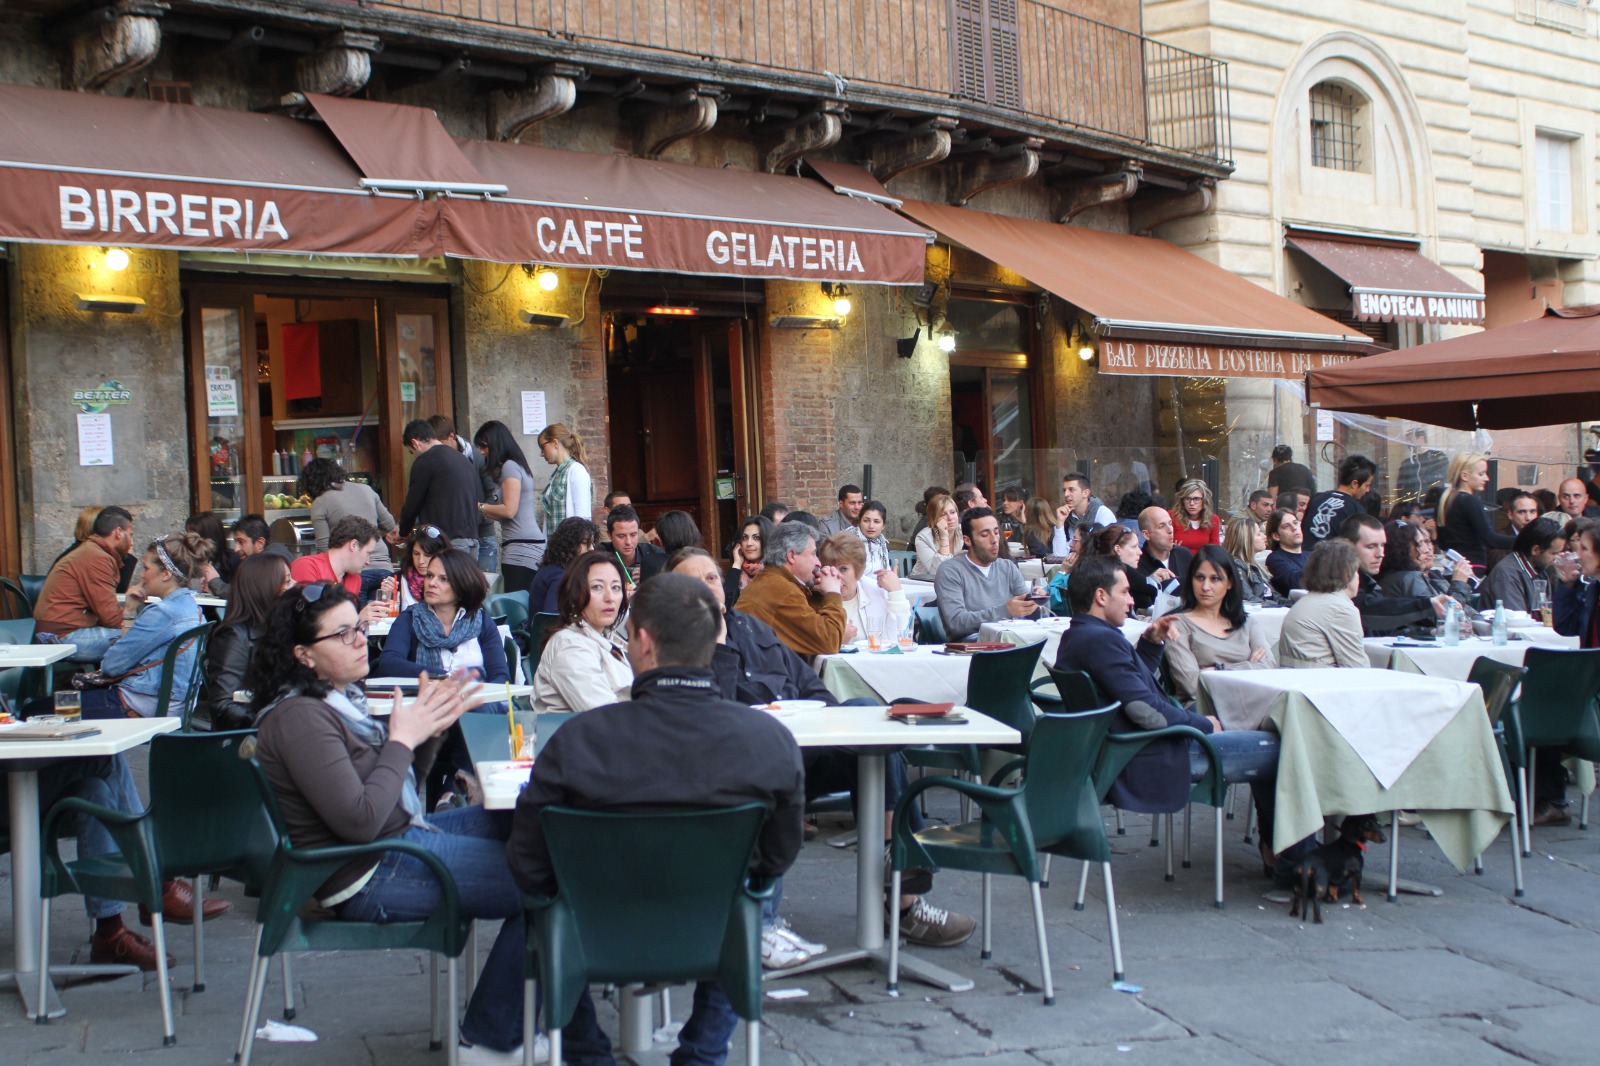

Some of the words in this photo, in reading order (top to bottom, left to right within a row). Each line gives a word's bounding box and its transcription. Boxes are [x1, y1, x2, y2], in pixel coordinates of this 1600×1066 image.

[59, 186, 289, 240] BIRRERIA
[536, 215, 644, 259] CAFFÈ
[705, 230, 865, 273] GELATERIA
[1360, 293, 1426, 316] ENOTECA
[1428, 297, 1478, 318] PANINI
[1105, 342, 1137, 367] BAR
[1145, 344, 1212, 370] PIZZERIA
[1291, 353, 1314, 374] DEL
[73, 391, 130, 400] BETTER
[657, 678, 680, 686] HELLY
